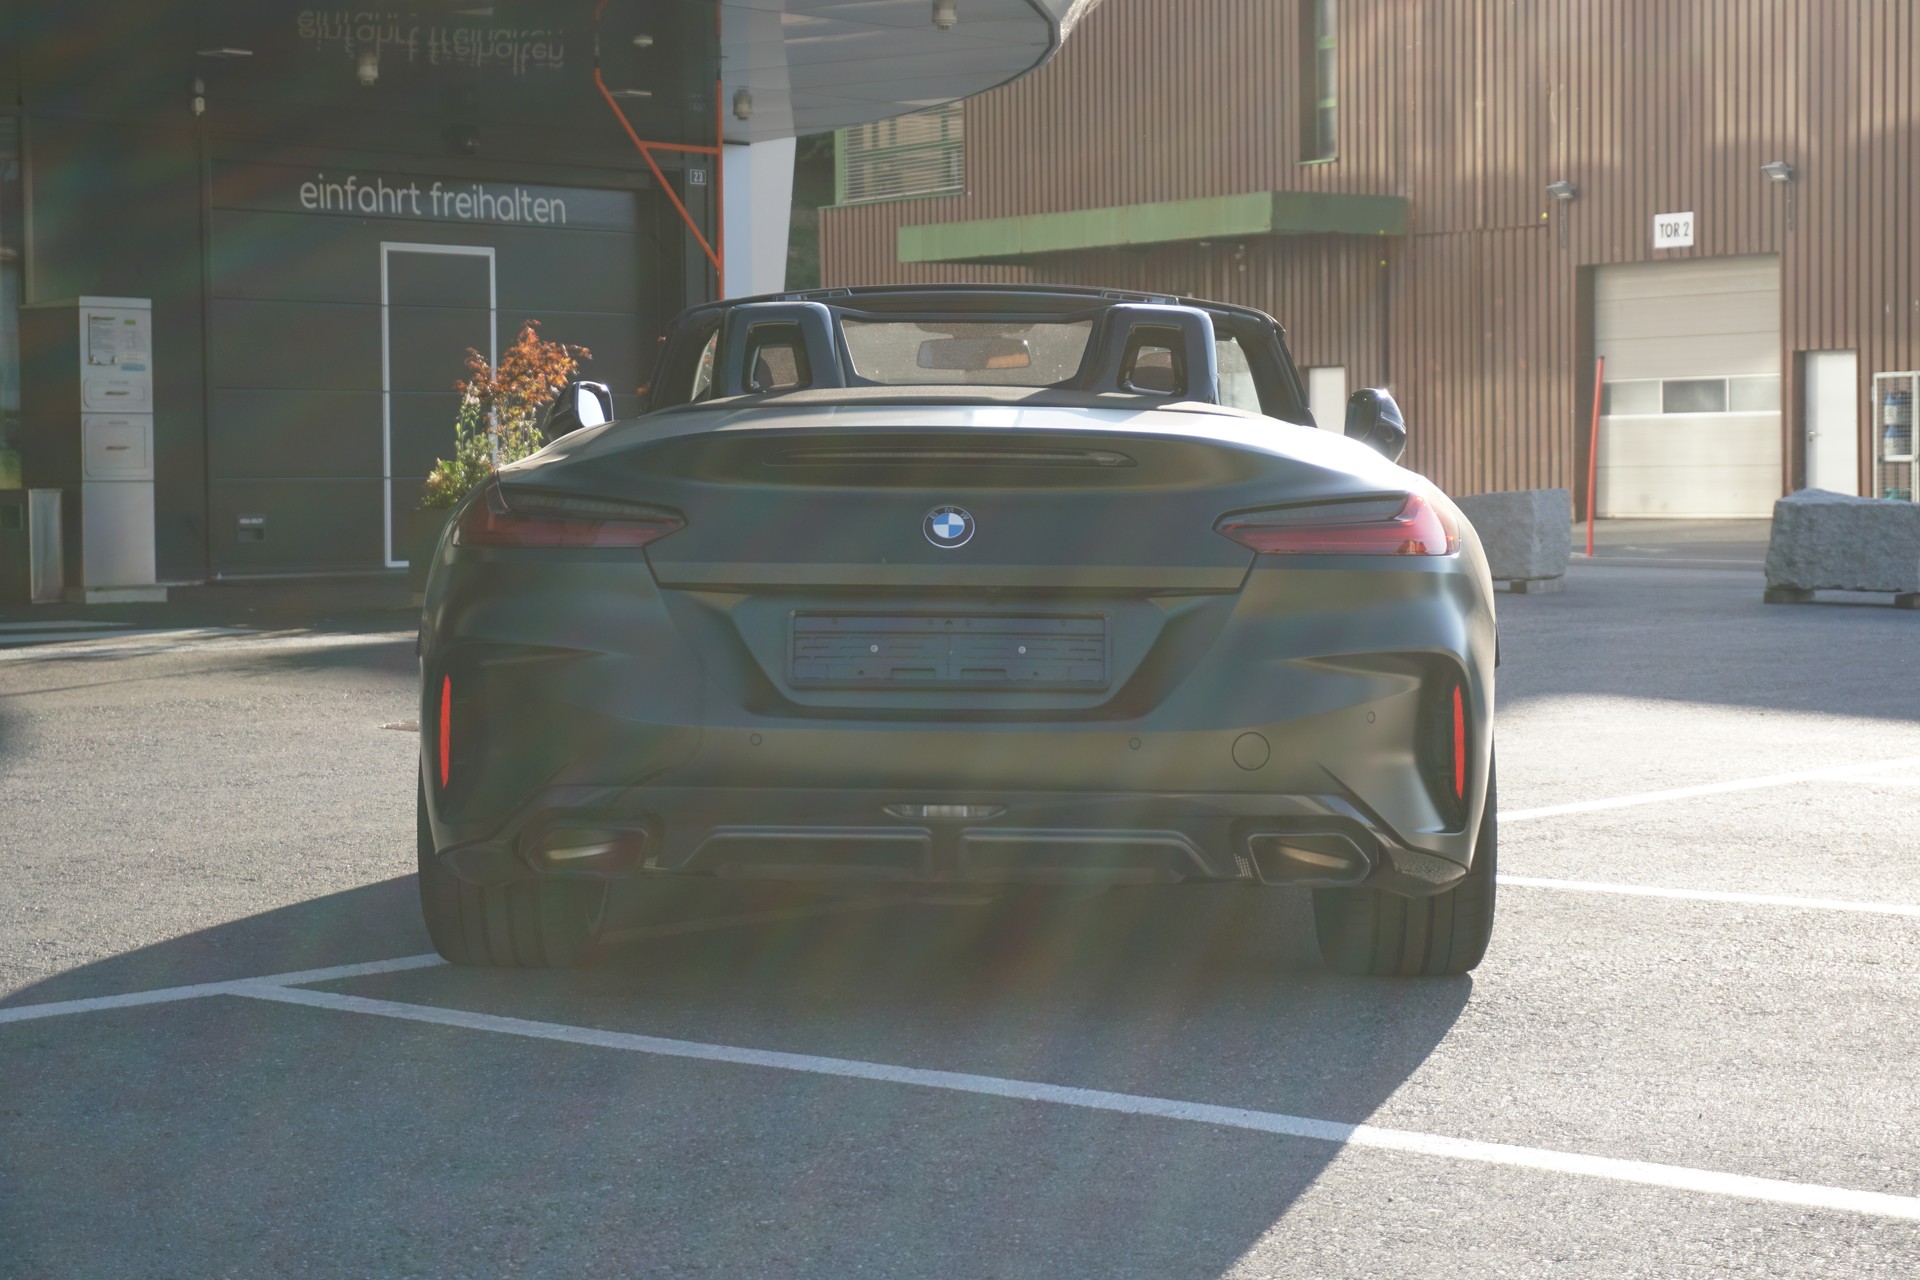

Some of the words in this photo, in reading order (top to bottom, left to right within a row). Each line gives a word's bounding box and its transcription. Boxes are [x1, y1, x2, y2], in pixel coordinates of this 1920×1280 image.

[693, 171, 703, 182] 23
[299, 173, 421, 215] einfahrt
[429, 181, 567, 224] freihalten
[1660, 222, 1680, 238] TOR
[1683, 221, 1690, 237] 2
